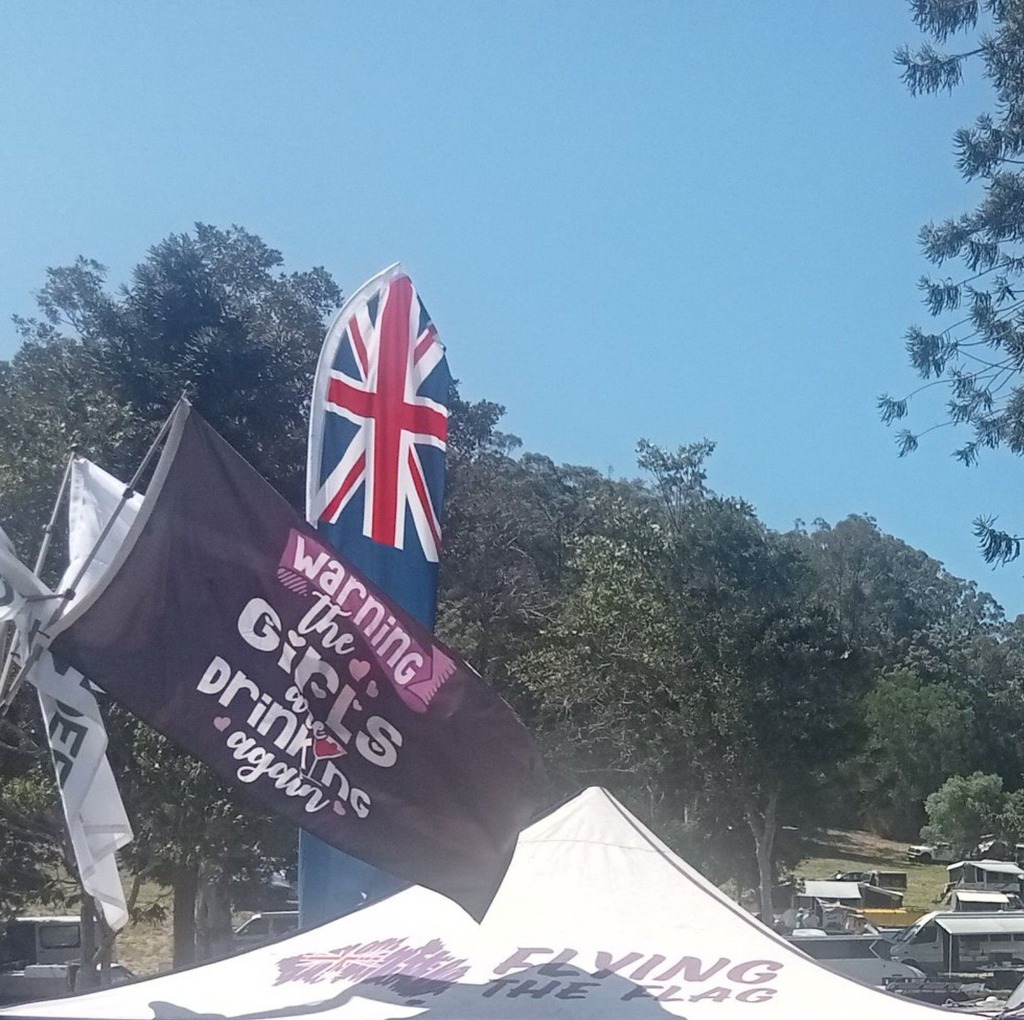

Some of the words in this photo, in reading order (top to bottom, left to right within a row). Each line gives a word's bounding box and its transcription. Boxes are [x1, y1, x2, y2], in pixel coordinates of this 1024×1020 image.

[298, 591, 355, 655] the
[226, 731, 331, 813] again
[481, 978, 601, 1000] THE
[620, 984, 779, 1003] FLAG
[493, 947, 784, 985] FLYING
